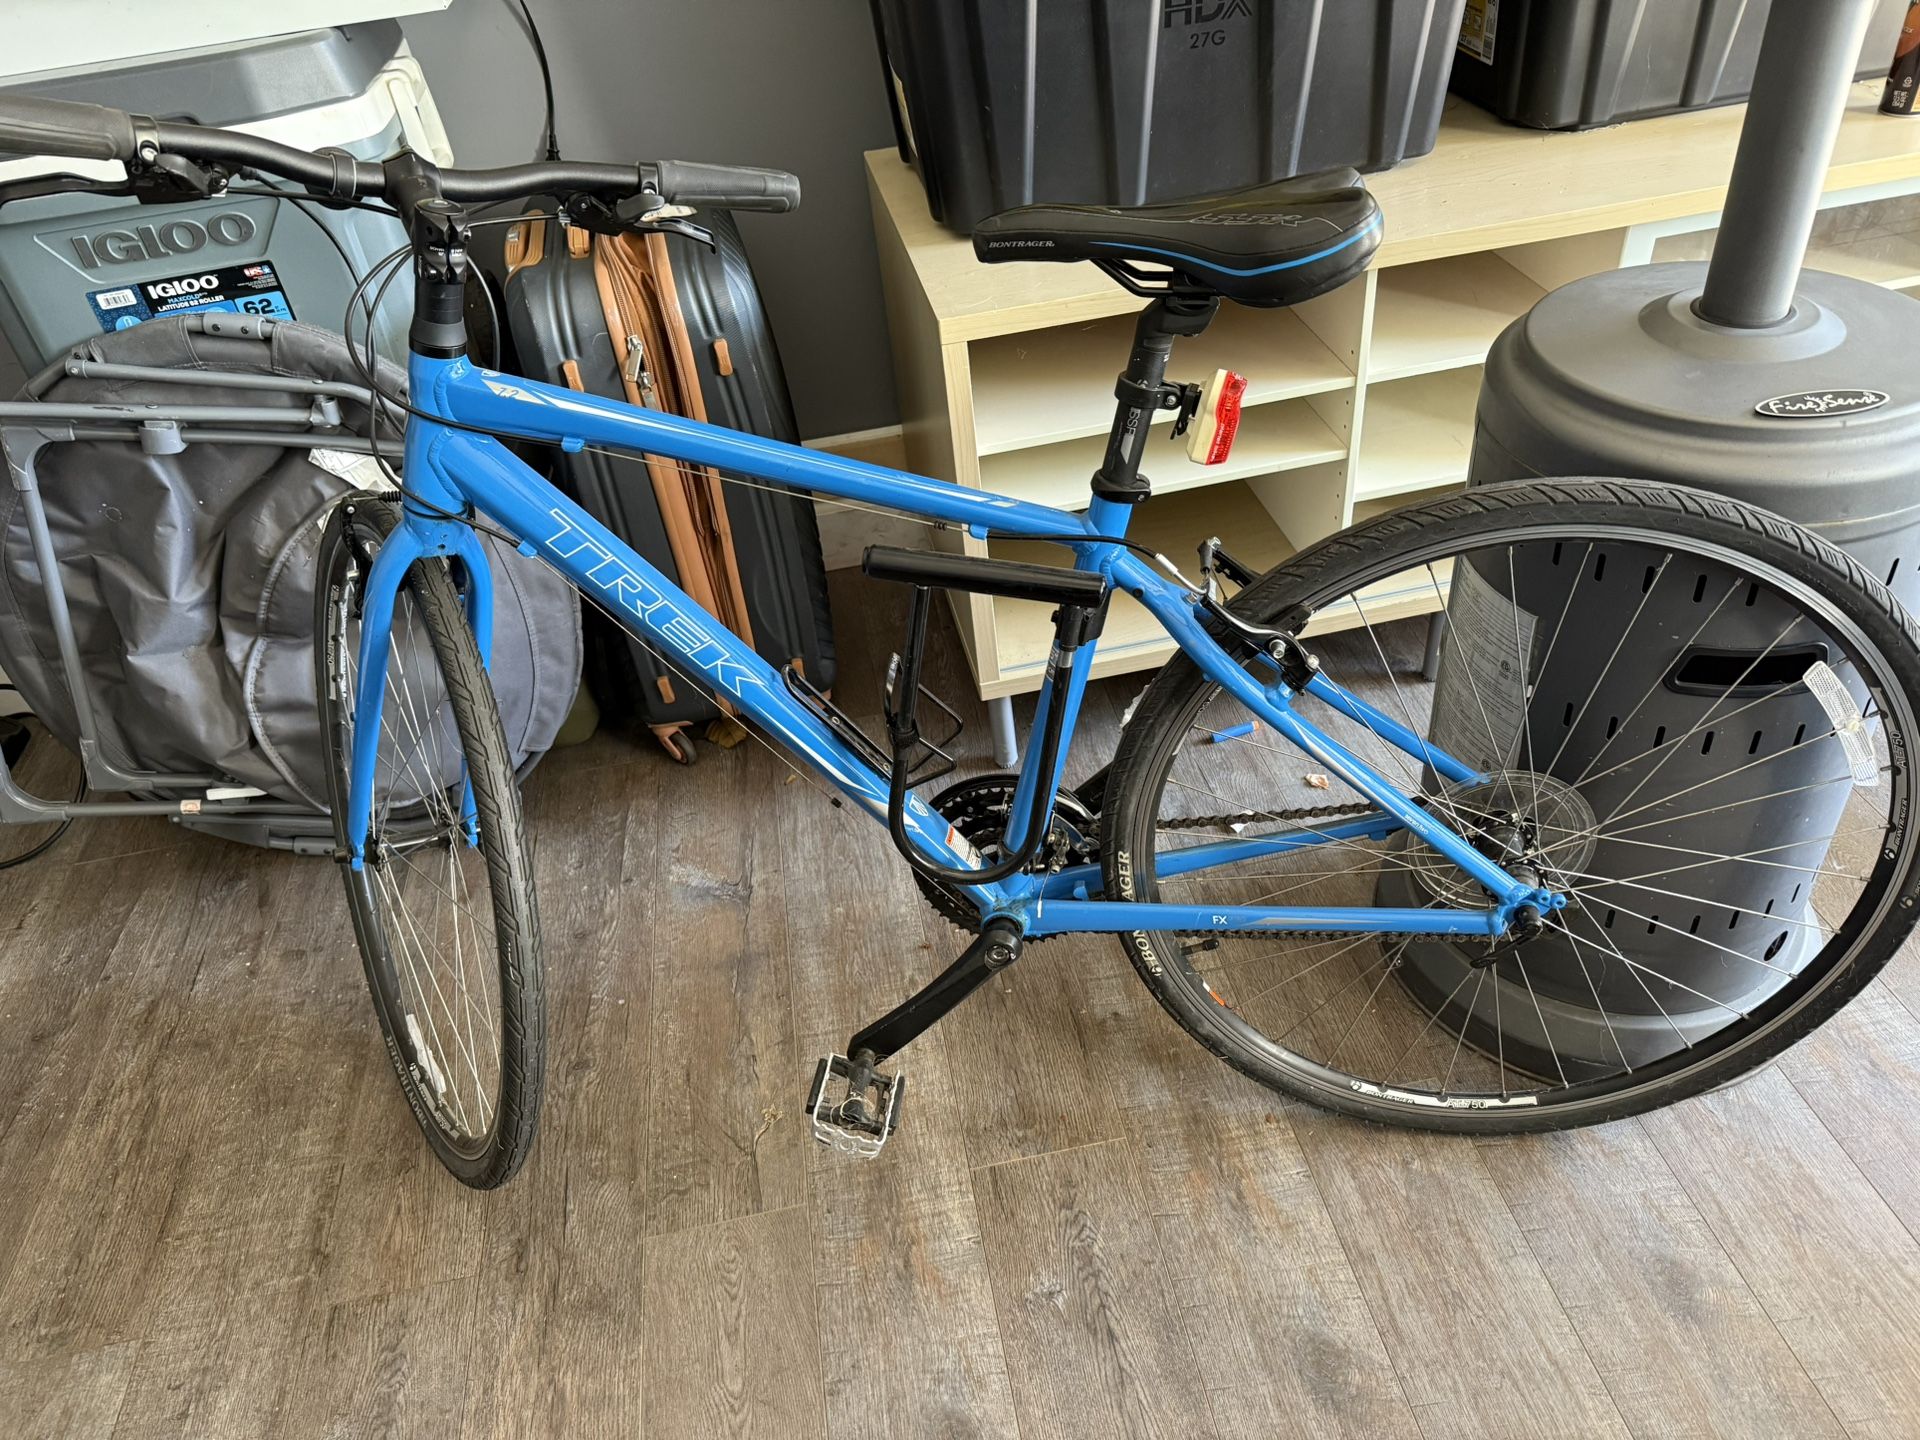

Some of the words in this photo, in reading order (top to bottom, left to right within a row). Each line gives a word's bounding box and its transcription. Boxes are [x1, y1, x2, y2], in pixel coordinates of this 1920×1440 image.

[1190, 30, 1226, 49] 27G
[71, 211, 256, 269] IGLOO
[988, 240, 1055, 248] BONTRAGER
[147, 275, 219, 299] IGLOO
[158, 301, 190, 312] LATITUDE
[199, 295, 225, 305] ROLLER
[243, 298, 275, 314] 62
[545, 508, 769, 697] TREK
[1212, 915, 1228, 925] FX
